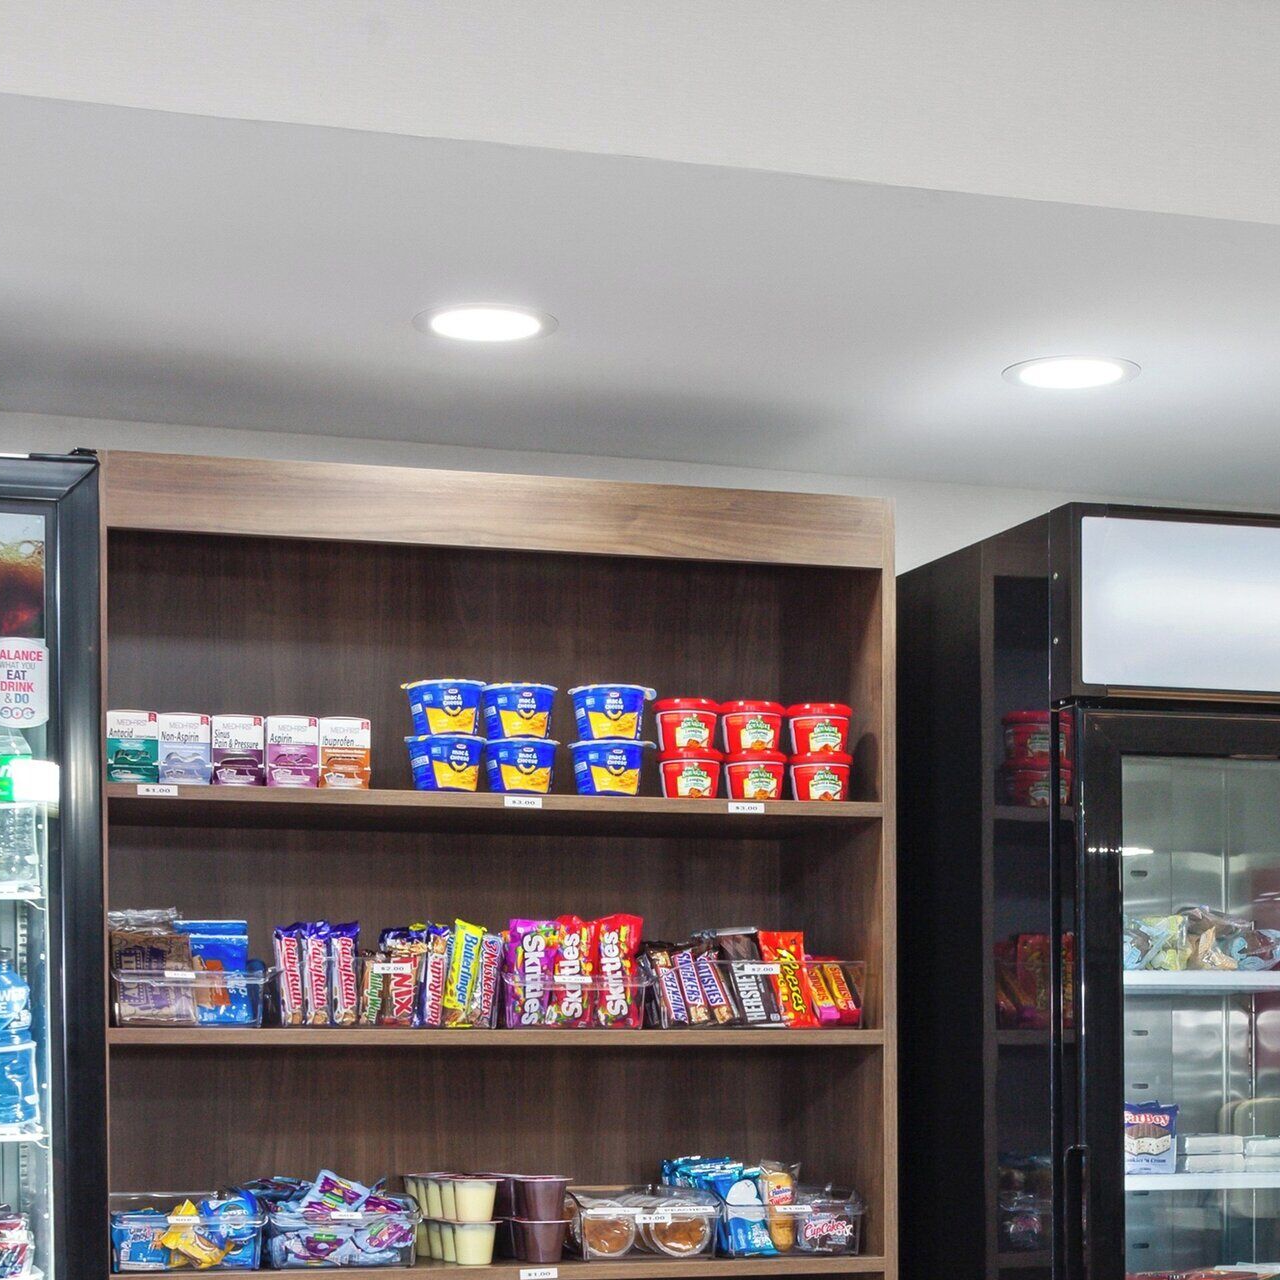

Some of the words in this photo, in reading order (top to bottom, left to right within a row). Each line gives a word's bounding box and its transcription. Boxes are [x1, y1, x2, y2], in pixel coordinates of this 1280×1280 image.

[21, 662, 36, 670] YOU
[6, 670, 27, 681] EAT
[0, 681, 34, 693] DRINK
[4, 693, 13, 704] &
[14, 694, 30, 704] DO
[108, 728, 134, 740] Antacid
[160, 731, 200, 744] Non-Aspirin
[214, 729, 231, 740] Sinus
[269, 733, 293, 745] Aspirin
[214, 738, 228, 749] Pain
[234, 740, 260, 751] Pressure
[322, 736, 356, 748] Ibuprofen
[456, 932, 479, 1006] Butterfinger
[561, 932, 583, 1018] Skitles
[522, 933, 547, 1026] Skittles
[678, 951, 701, 1004] SNICKERS
[776, 948, 807, 1014] Reese's
[481, 950, 499, 1019] Musketeers
[732, 962, 767, 1022] HERSHEY
